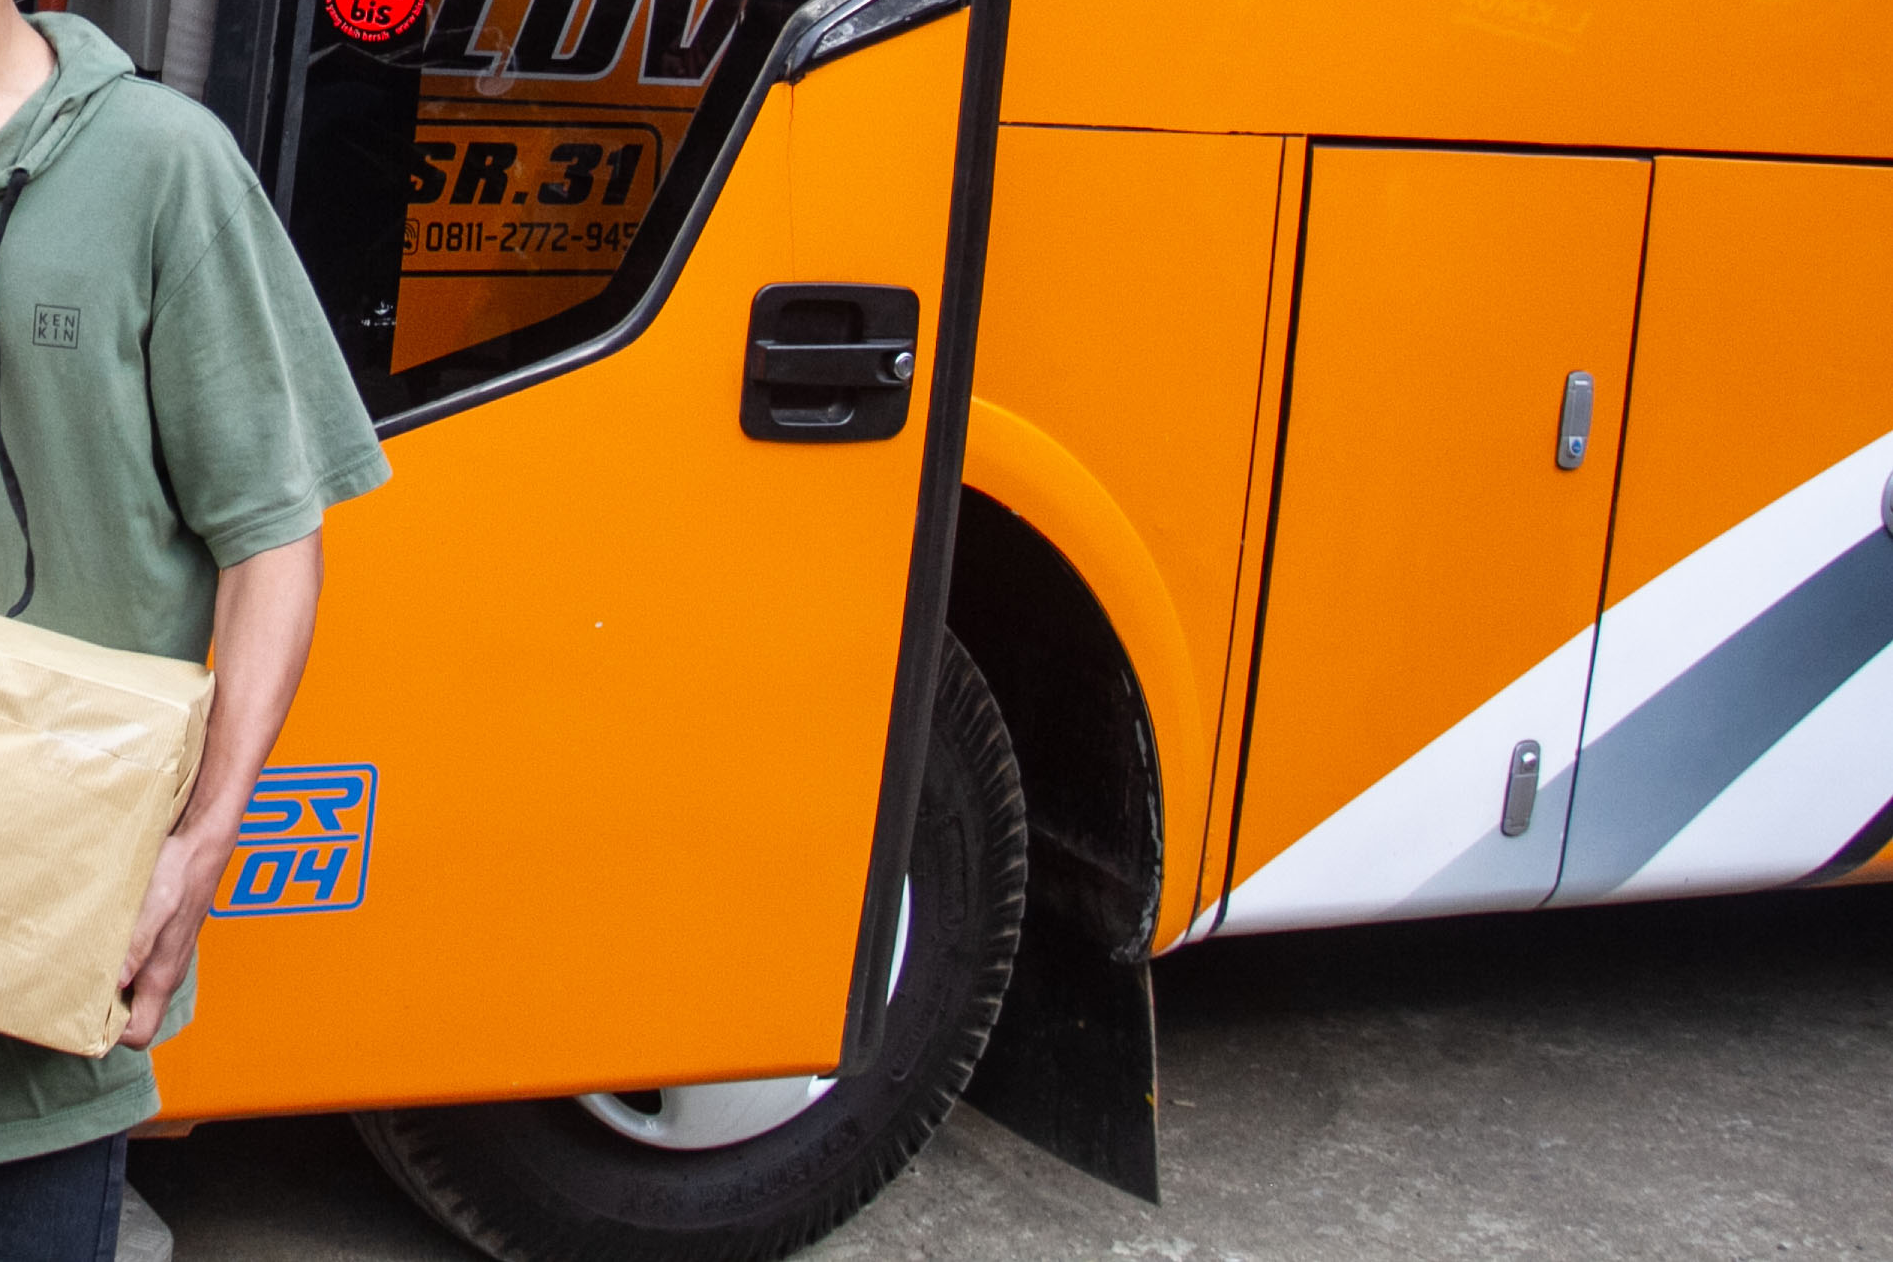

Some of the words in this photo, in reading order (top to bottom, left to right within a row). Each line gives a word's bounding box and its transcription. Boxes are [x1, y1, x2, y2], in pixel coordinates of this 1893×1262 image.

[408, 142, 644, 206] SR.31
[38, 312, 75, 328] KEN
[38, 327, 74, 342] KIN
[238, 775, 365, 834] SR
[229, 847, 349, 906] 04
